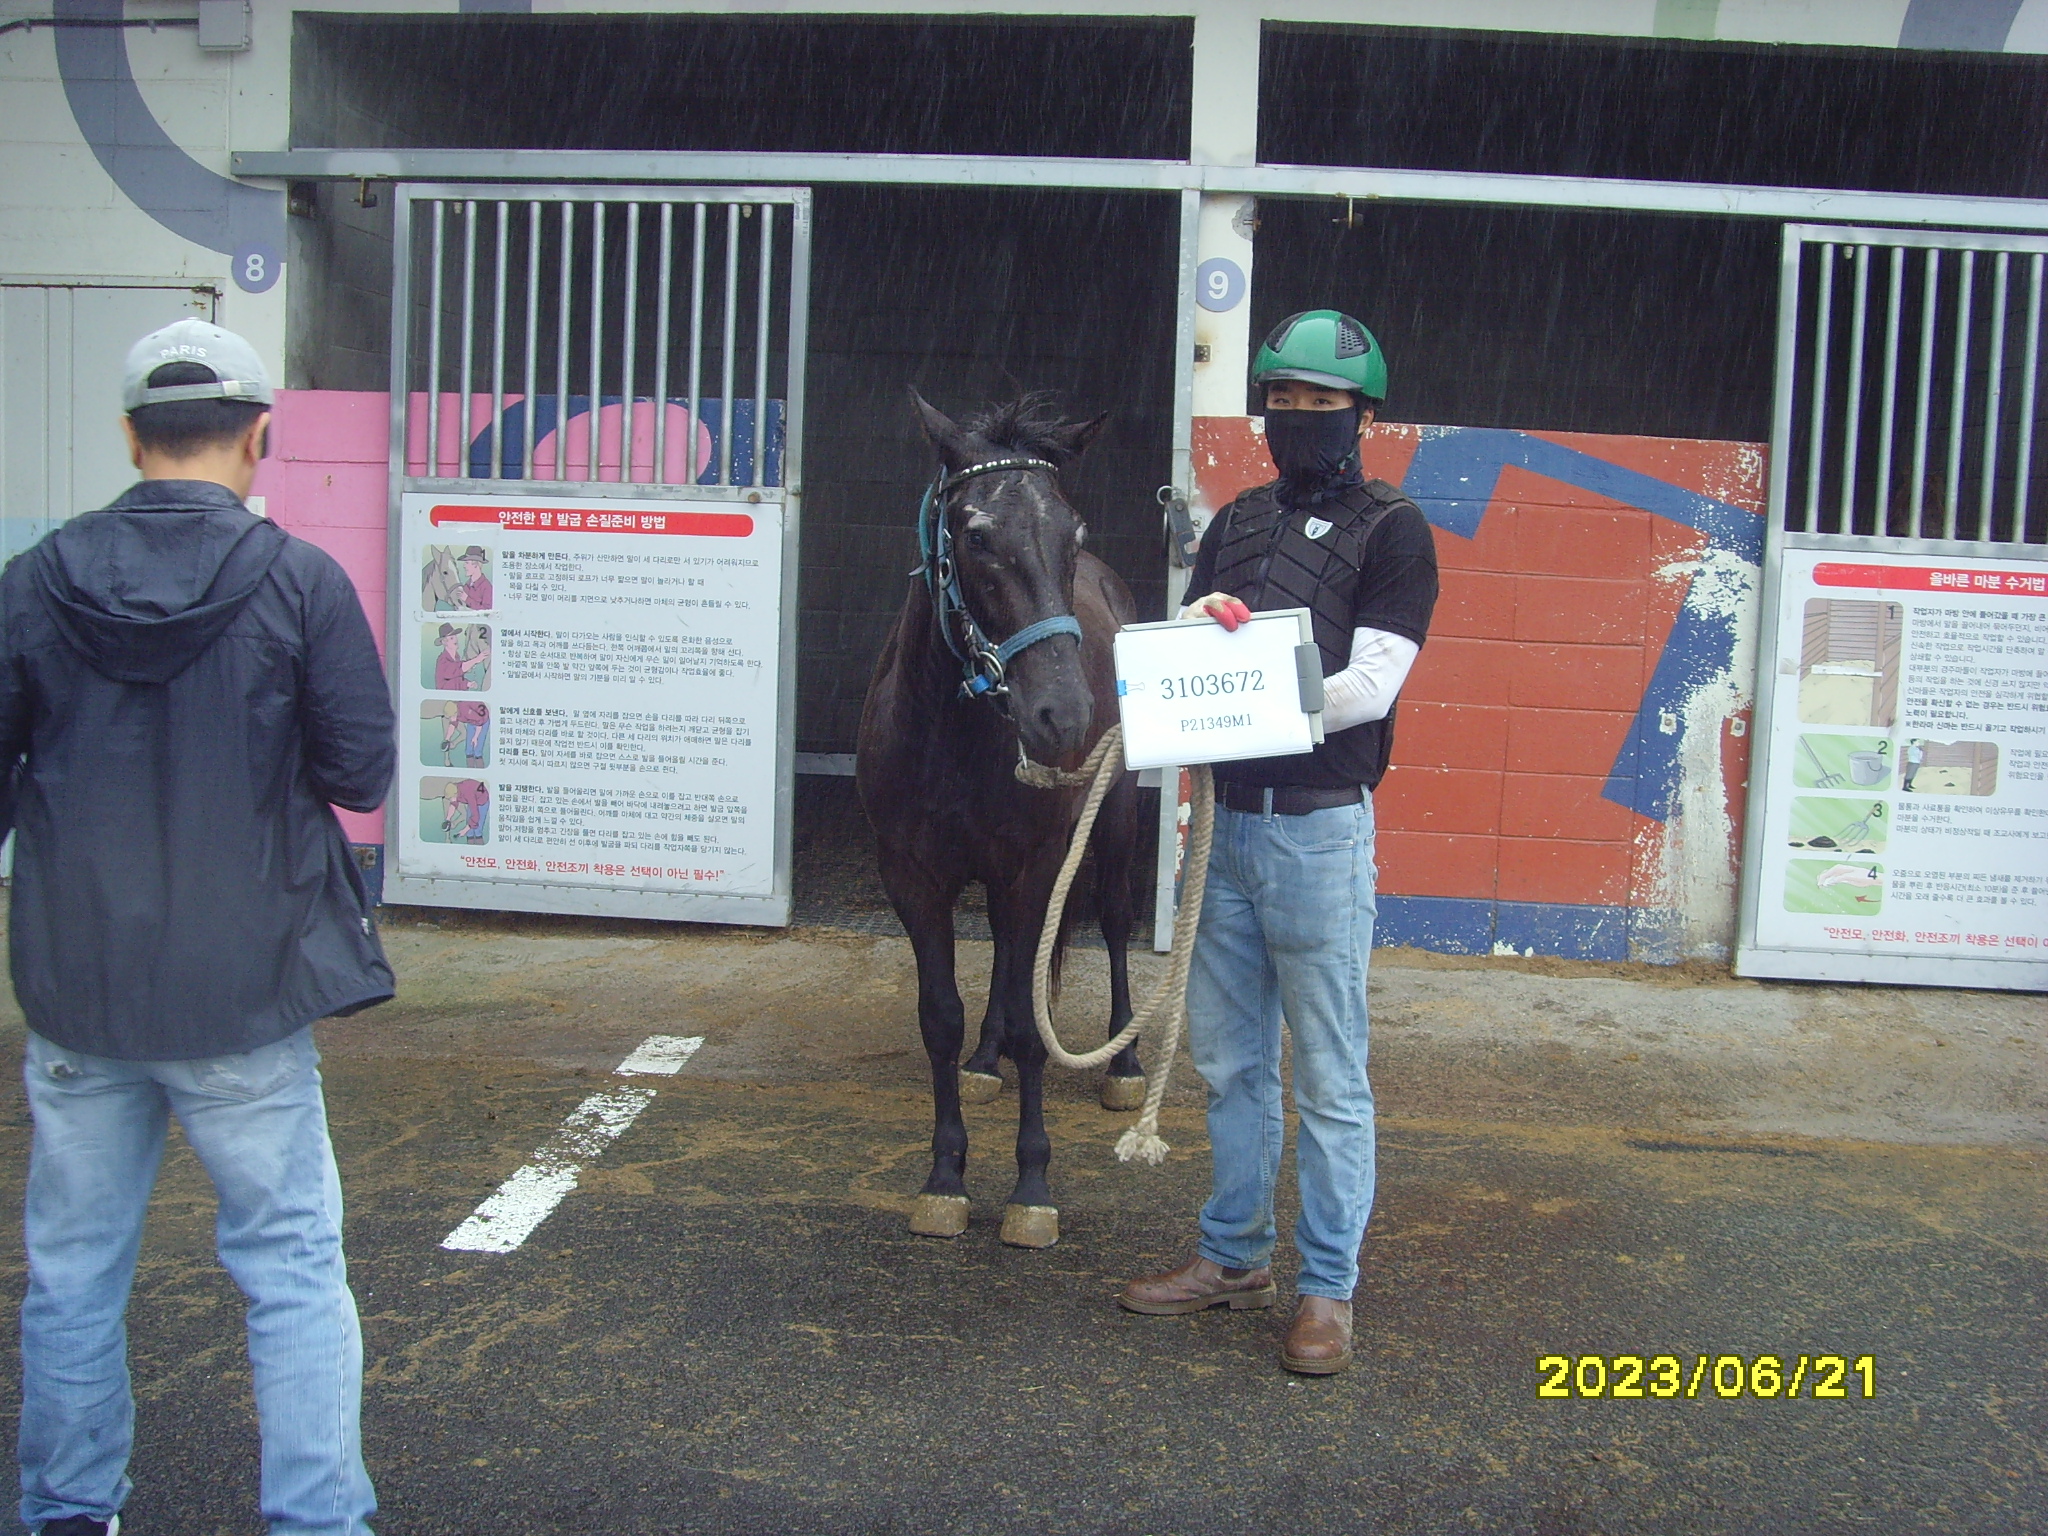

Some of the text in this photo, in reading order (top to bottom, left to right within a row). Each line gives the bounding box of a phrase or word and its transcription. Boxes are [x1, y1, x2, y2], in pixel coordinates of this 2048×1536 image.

[245, 253, 264, 282] 8
[1207, 270, 1229, 300] 9
[160, 344, 208, 359] PARIS
[497, 510, 665, 529] 안전한 말 발굽 손질준비 방법
[1929, 571, 2045, 591] 올바른 마분 수거법
[1888, 605, 1895, 620] 1
[479, 627, 487, 640] 2
[1160, 669, 1265, 700] 3103672
[477, 704, 487, 717] 3
[1180, 713, 1253, 732] P21349M1
[1877, 740, 1888, 755] 2
[477, 781, 485, 794] 4
[1873, 803, 1883, 818] 3
[504, 858, 541, 871] 안전화,
[544, 860, 589, 874] 안전조끼
[592, 862, 626, 876] 착용은
[629, 865, 662, 878] 선택이
[666, 867, 689, 880] 아닌
[1867, 866, 1878, 880] 4
[1871, 928, 1909, 942] 안전화,
[1913, 930, 1960, 945] 안전조끼
[1964, 932, 2000, 947] 착용은
[2003, 935, 2038, 949] 선택이
